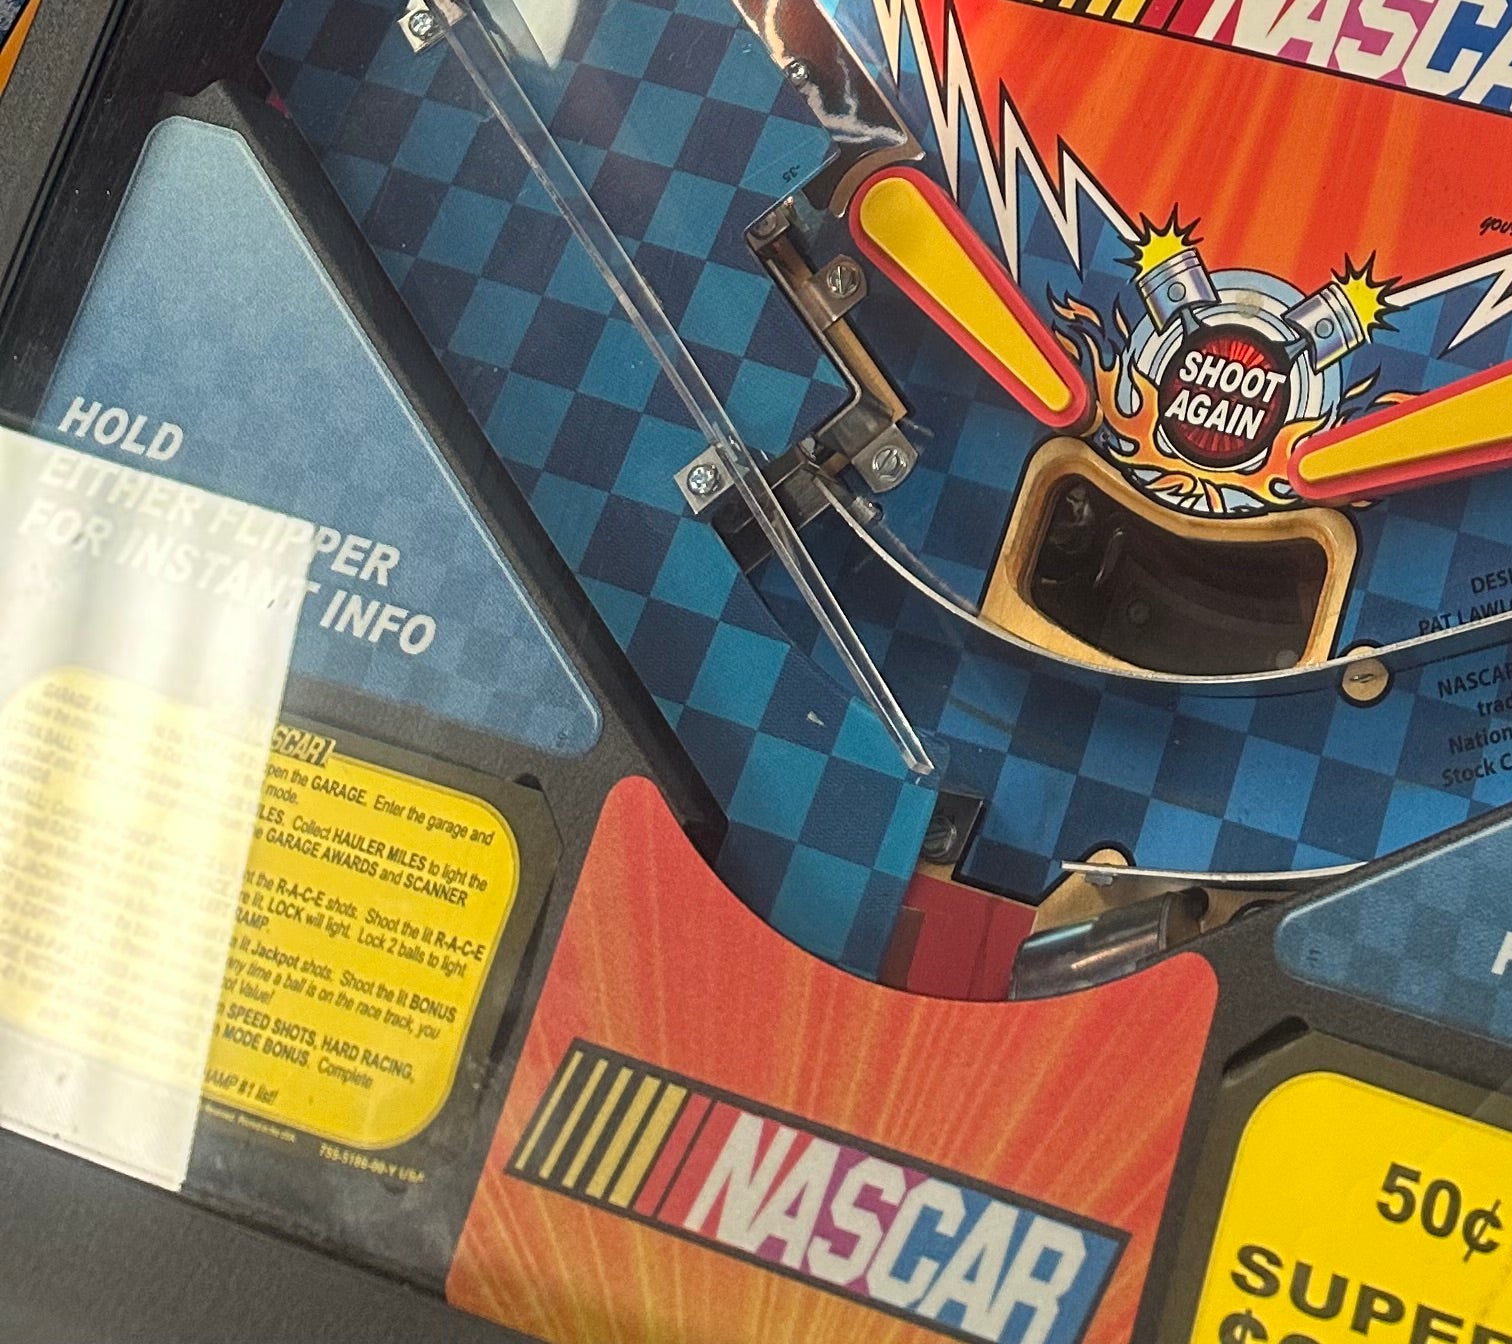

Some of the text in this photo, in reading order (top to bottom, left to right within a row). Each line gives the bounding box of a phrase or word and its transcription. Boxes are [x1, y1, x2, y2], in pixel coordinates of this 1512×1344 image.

[1178, 350, 1287, 403] SHOOT
[56, 394, 185, 462] HOLD
[1165, 388, 1267, 440] AGAIN
[319, 594, 437, 656] INFO
[1441, 759, 1496, 788] Stock
[310, 775, 495, 846] GARAGE. Enter the garage and
[292, 814, 426, 871] Collect HAULER MILES
[321, 847, 467, 907] AWARDS and SCANNER
[682, 1110, 1088, 1344] NASCAR
